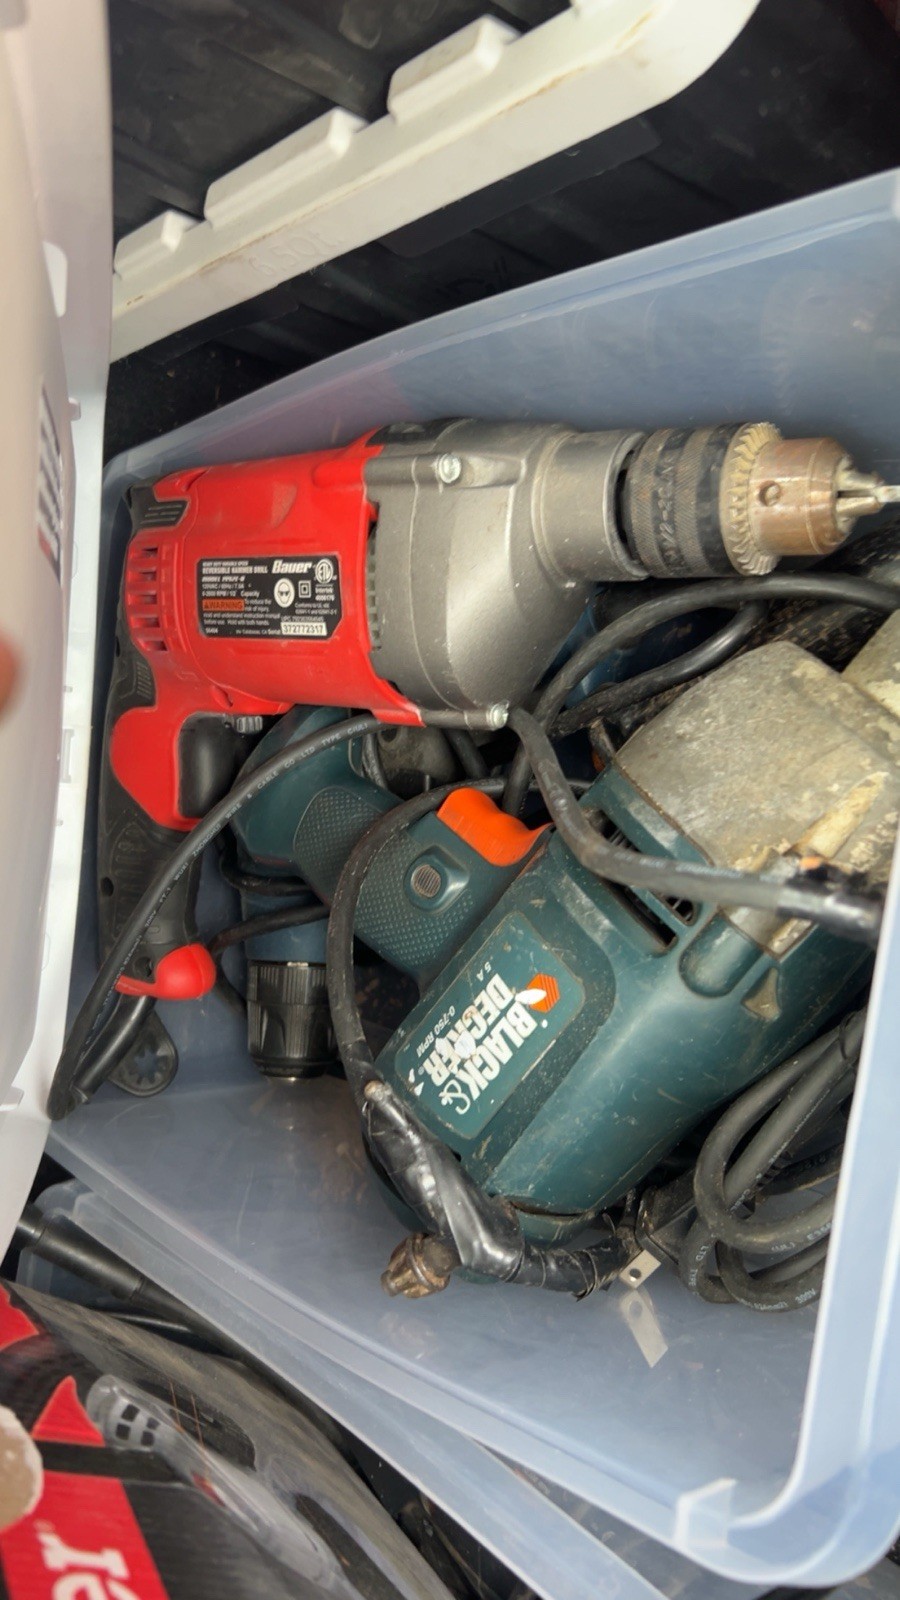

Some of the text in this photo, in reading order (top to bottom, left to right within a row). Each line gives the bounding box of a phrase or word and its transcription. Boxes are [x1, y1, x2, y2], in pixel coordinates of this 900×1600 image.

[231, 566, 253, 574] HAMMER
[254, 565, 268, 573] DRILL
[271, 559, 312, 574] Bauer
[208, 601, 243, 610] WARNING
[282, 624, 324, 634] 372772317
[225, 803, 242, 819] WIRE
[256, 770, 279, 790] CABLE
[283, 757, 296, 769] CO
[300, 746, 316, 758] LTD
[321, 732, 342, 746] TYPE
[416, 1005, 456, 1058] 0-750 RPM
[438, 1001, 538, 1115] BLACK &
